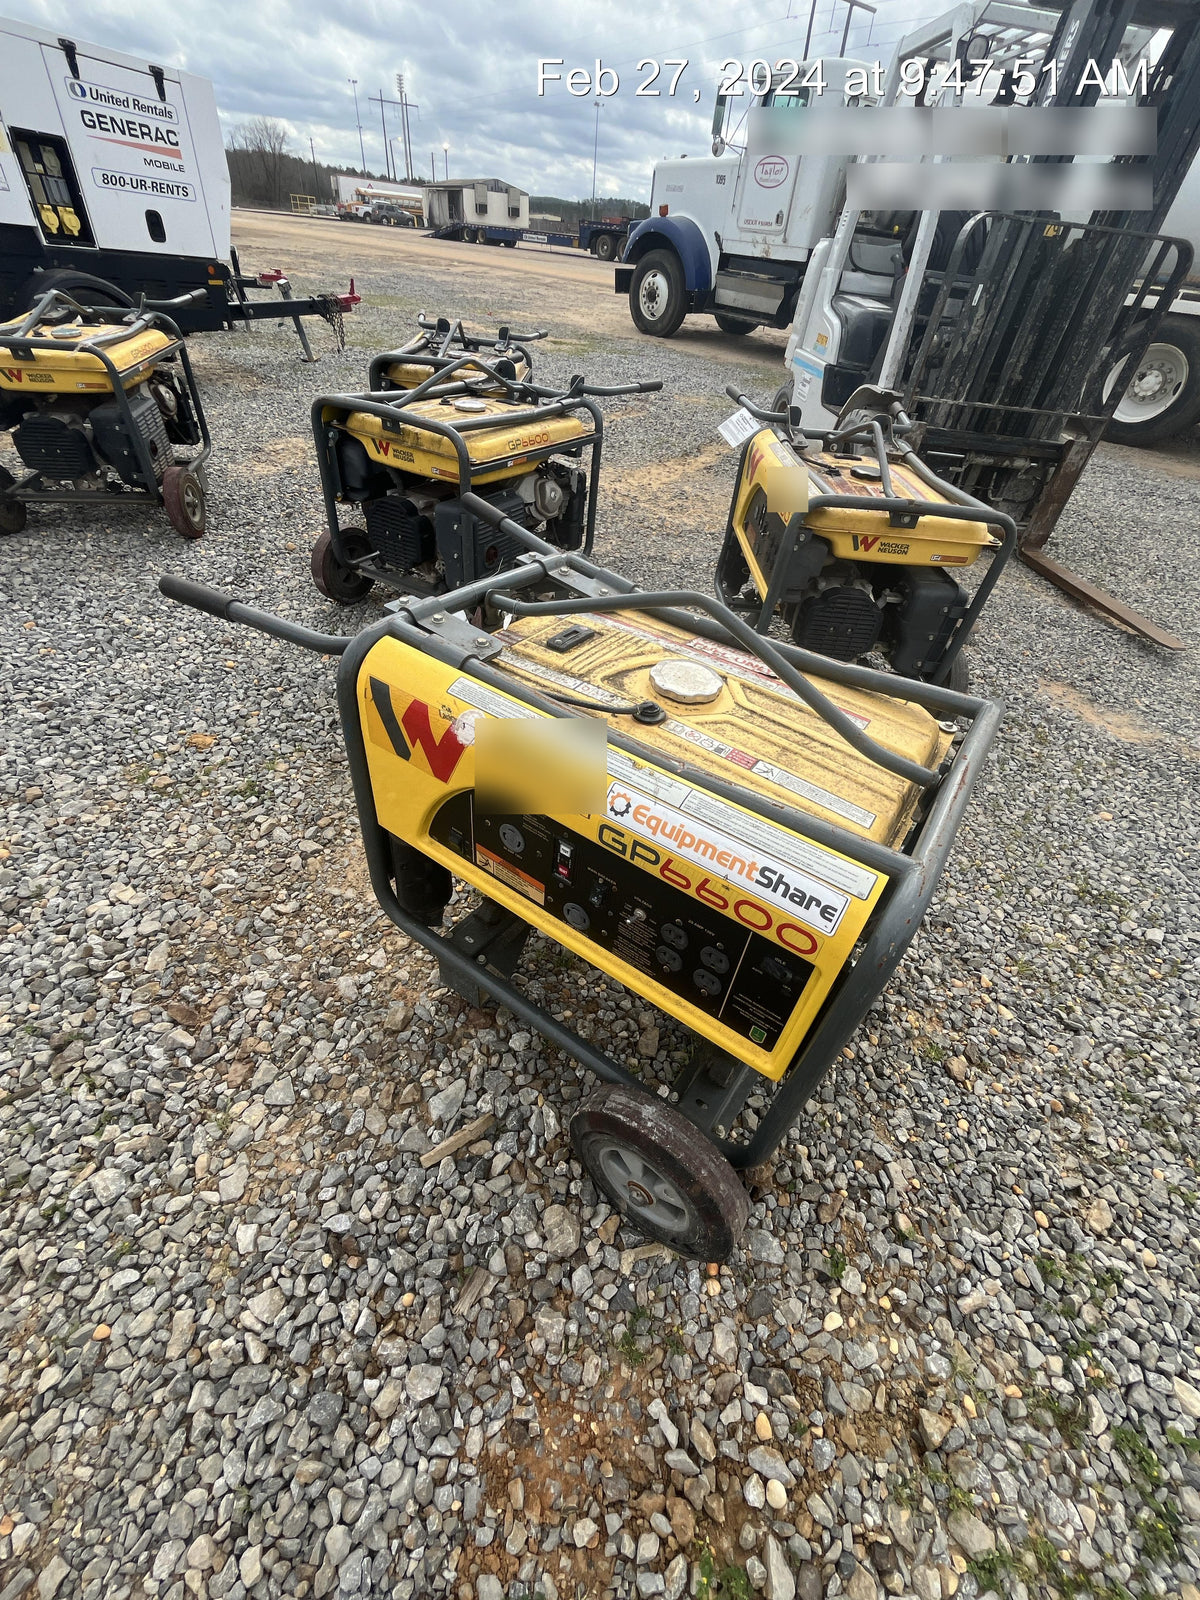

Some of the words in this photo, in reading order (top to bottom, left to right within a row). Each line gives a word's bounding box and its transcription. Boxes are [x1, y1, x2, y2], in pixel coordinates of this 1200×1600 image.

[88, 86, 130, 109] United
[132, 98, 174, 120] Rentals
[80, 109, 180, 147] GENERAC
[143, 157, 186, 173] MOBILE
[101, 173, 189, 198] 800-UR-RENTS
[507, 432, 549, 451] GP6600
[877, 546, 910, 556] NEUSON
[879, 541, 911, 550] WACKER
[632, 804, 839, 924] EquipmentShare
[597, 823, 819, 956] GP6600
